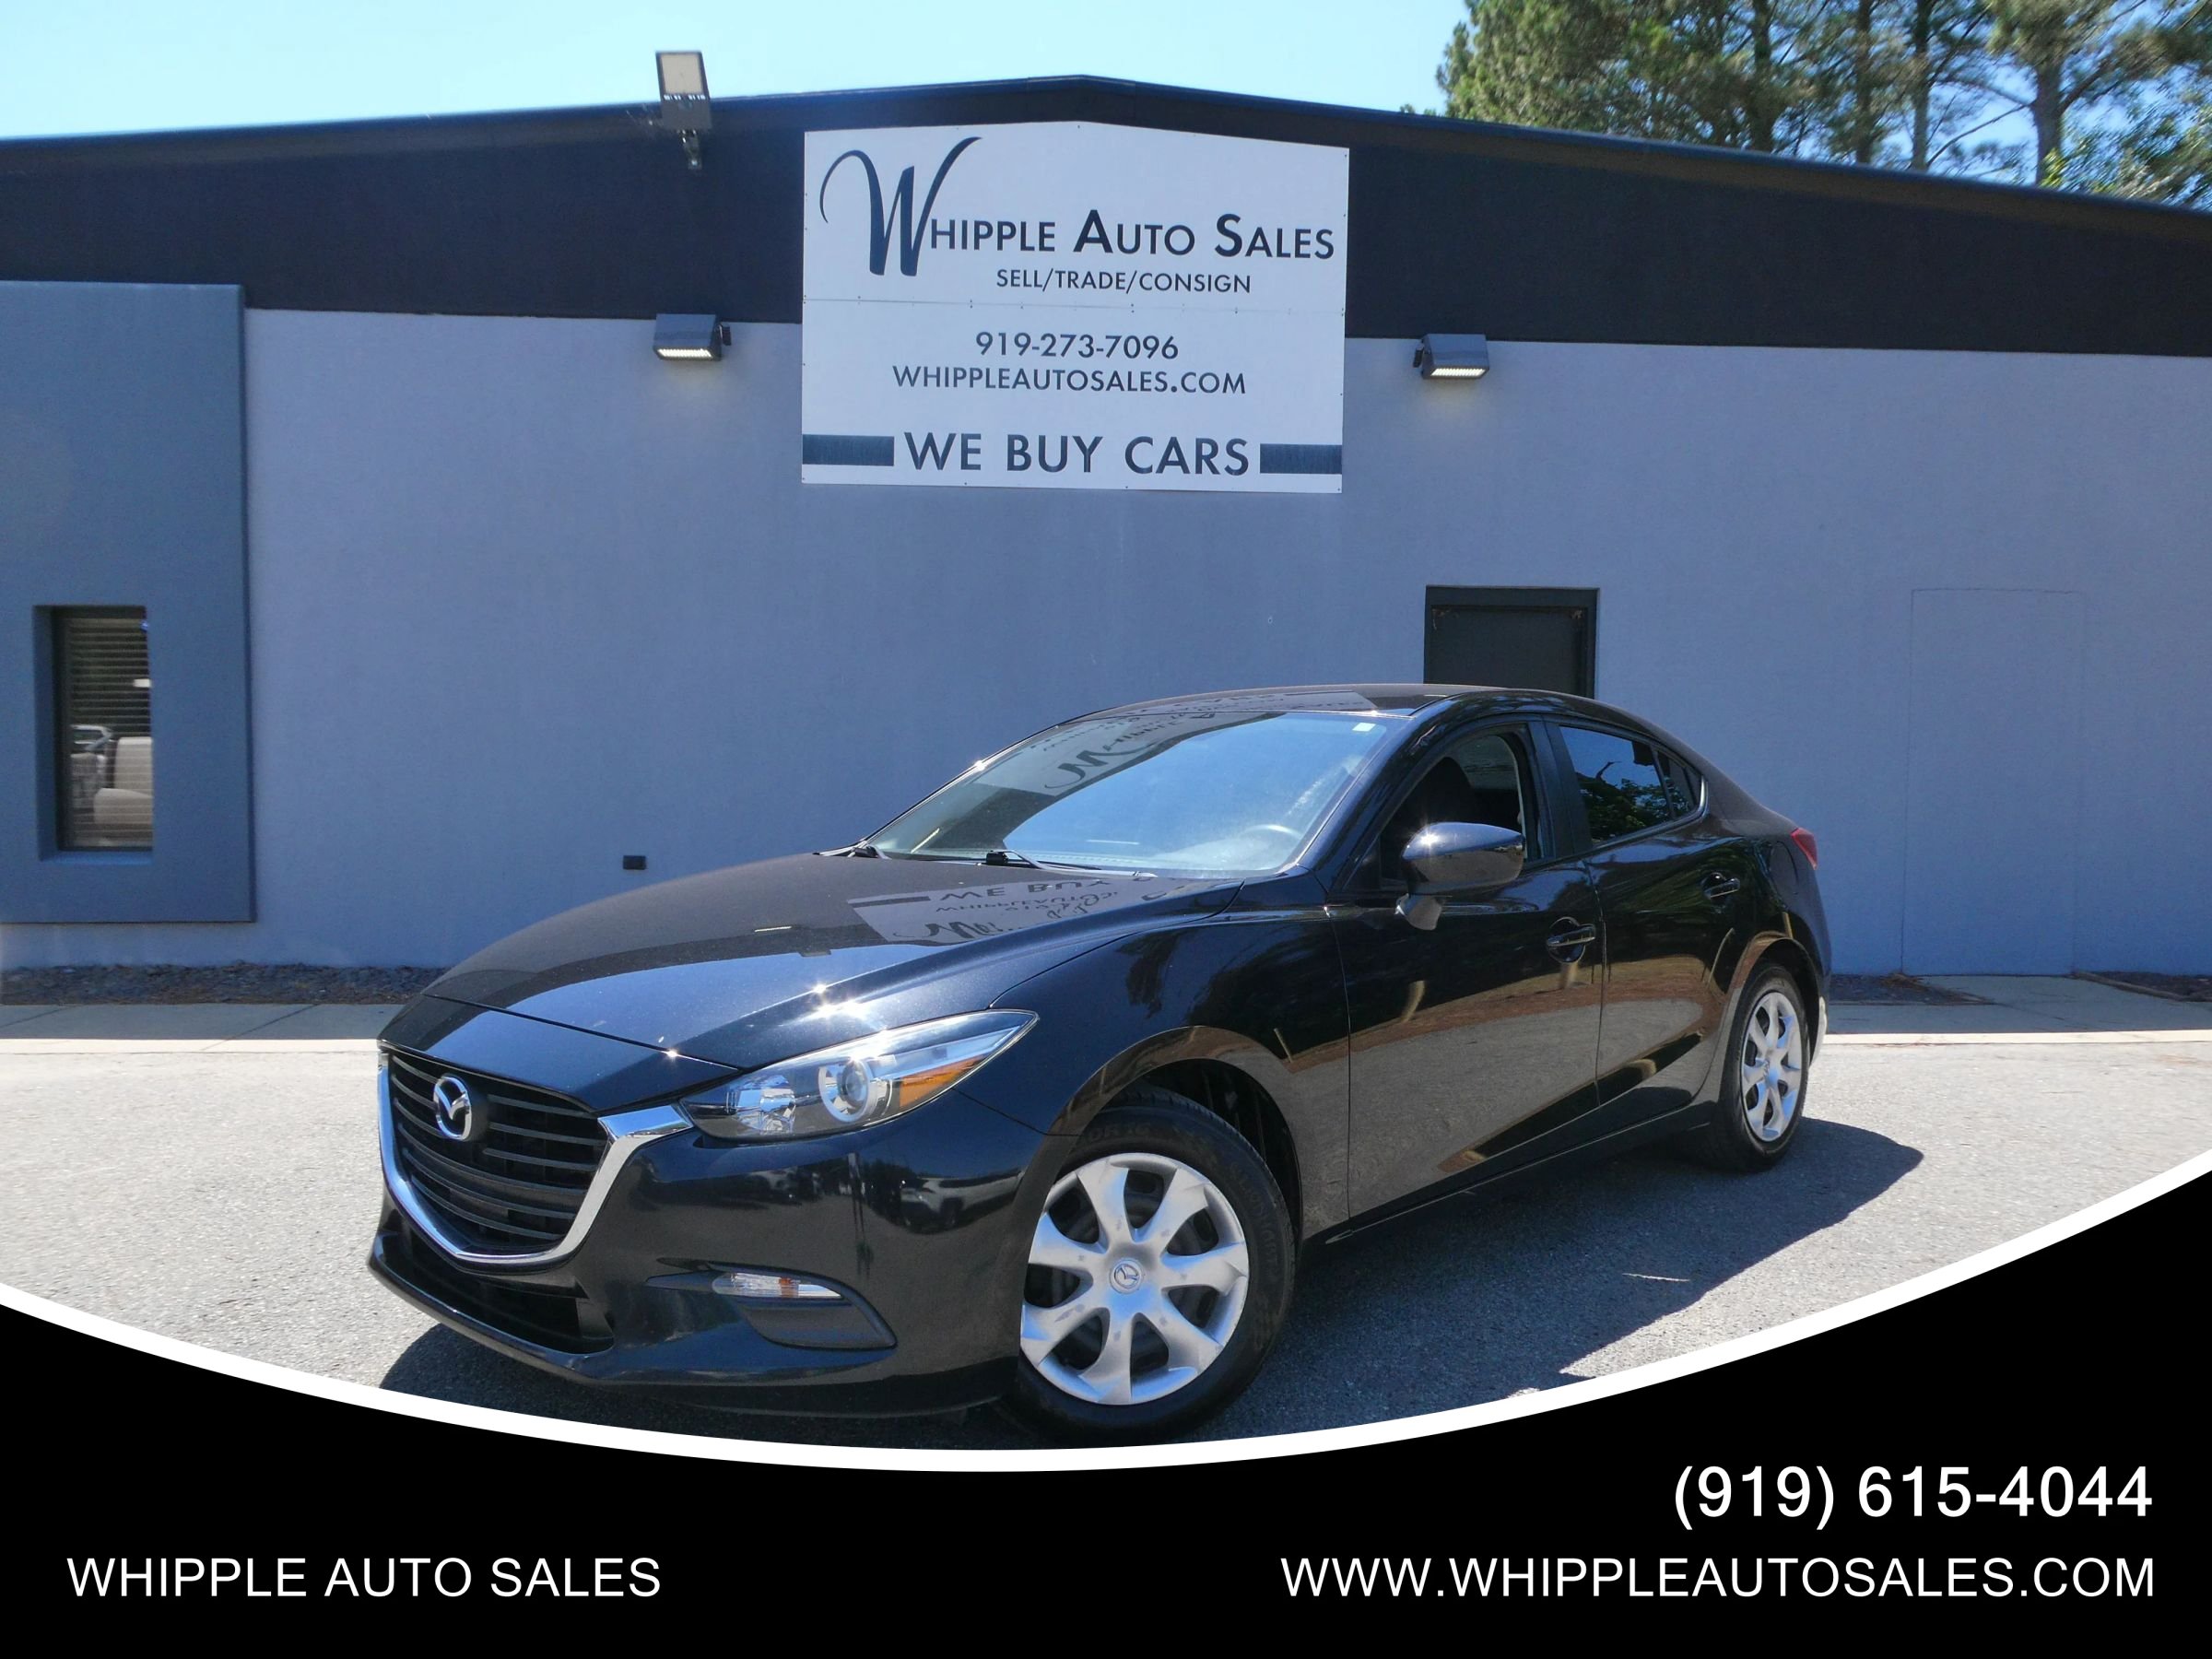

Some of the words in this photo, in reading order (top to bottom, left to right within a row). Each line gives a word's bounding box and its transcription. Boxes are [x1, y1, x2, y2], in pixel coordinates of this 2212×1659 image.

[1073, 209, 1195, 256] AUTO
[1215, 213, 1335, 260] SALES
[996, 268, 1252, 294] SELL/TRADE/CONSIGN
[975, 331, 1180, 359] 919-273-7096
[892, 365, 1246, 394] WHIPPLEAUTOSALES.COM
[903, 431, 982, 471] WE
[1006, 434, 1104, 473] BUY
[1124, 436, 1250, 477] CARS
